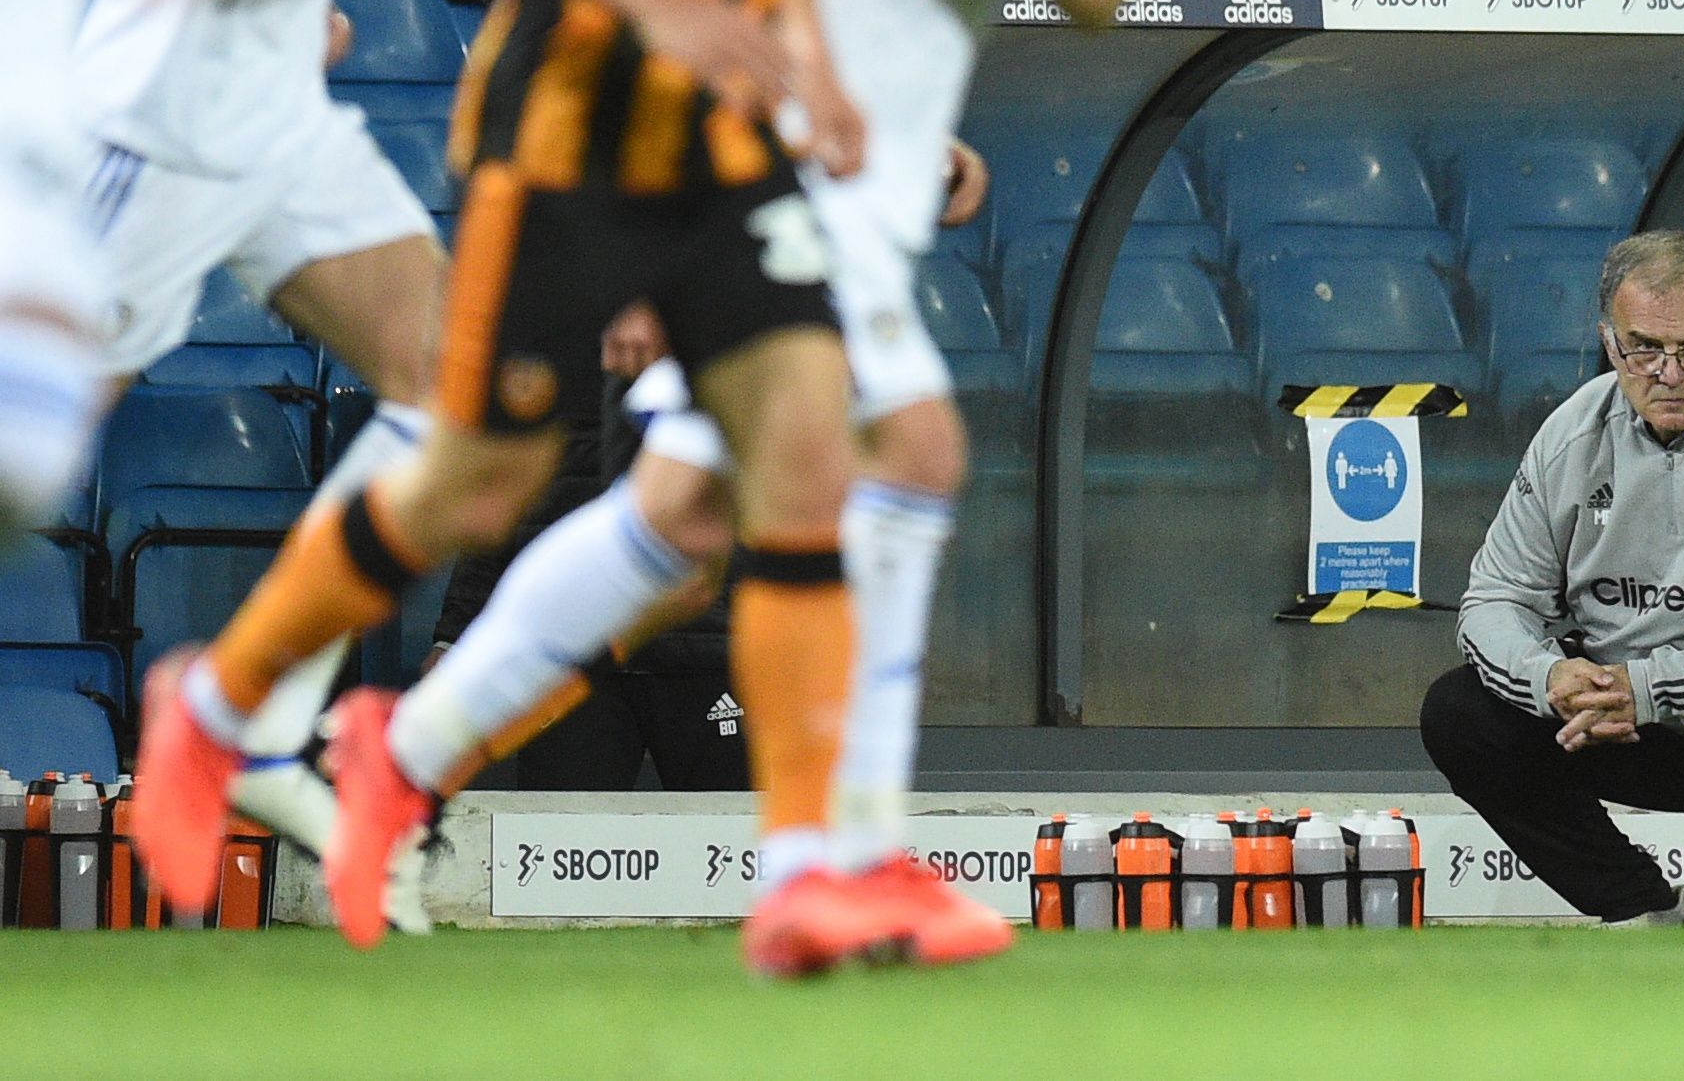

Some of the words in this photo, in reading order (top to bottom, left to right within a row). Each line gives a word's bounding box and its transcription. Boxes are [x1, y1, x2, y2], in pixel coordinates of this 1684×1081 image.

[1115, 0, 1183, 23] adidas
[1224, 1, 1293, 24] adidas
[1319, 557, 1328, 567] 2
[1359, 557, 1381, 568] apart
[1338, 545, 1367, 556] Please
[1368, 545, 1391, 557] keep
[706, 707, 745, 721] adidas
[553, 849, 660, 881] SBOTOP
[927, 850, 1032, 883] SBOTOP
